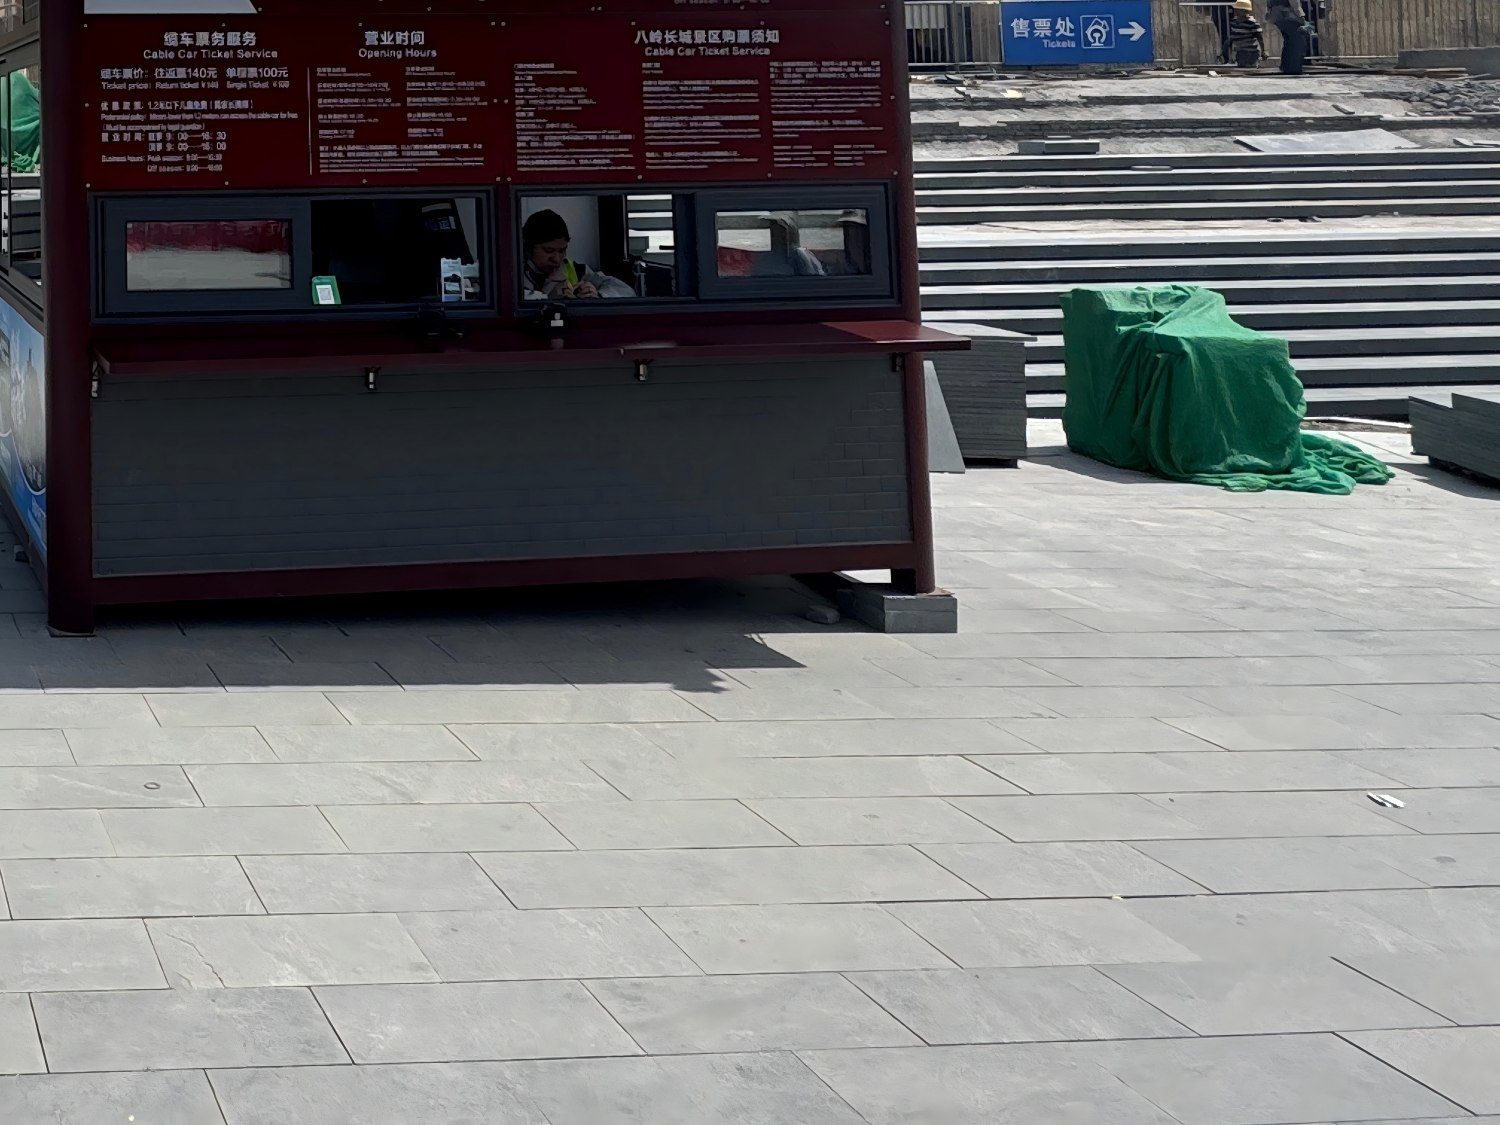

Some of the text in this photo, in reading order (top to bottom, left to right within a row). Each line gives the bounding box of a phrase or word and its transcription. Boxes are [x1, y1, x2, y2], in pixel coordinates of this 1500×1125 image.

[1010, 17, 1075, 38] 售票处
[143, 48, 278, 60] Cable Car Ticket Service
[358, 47, 438, 60] Opening Hours
